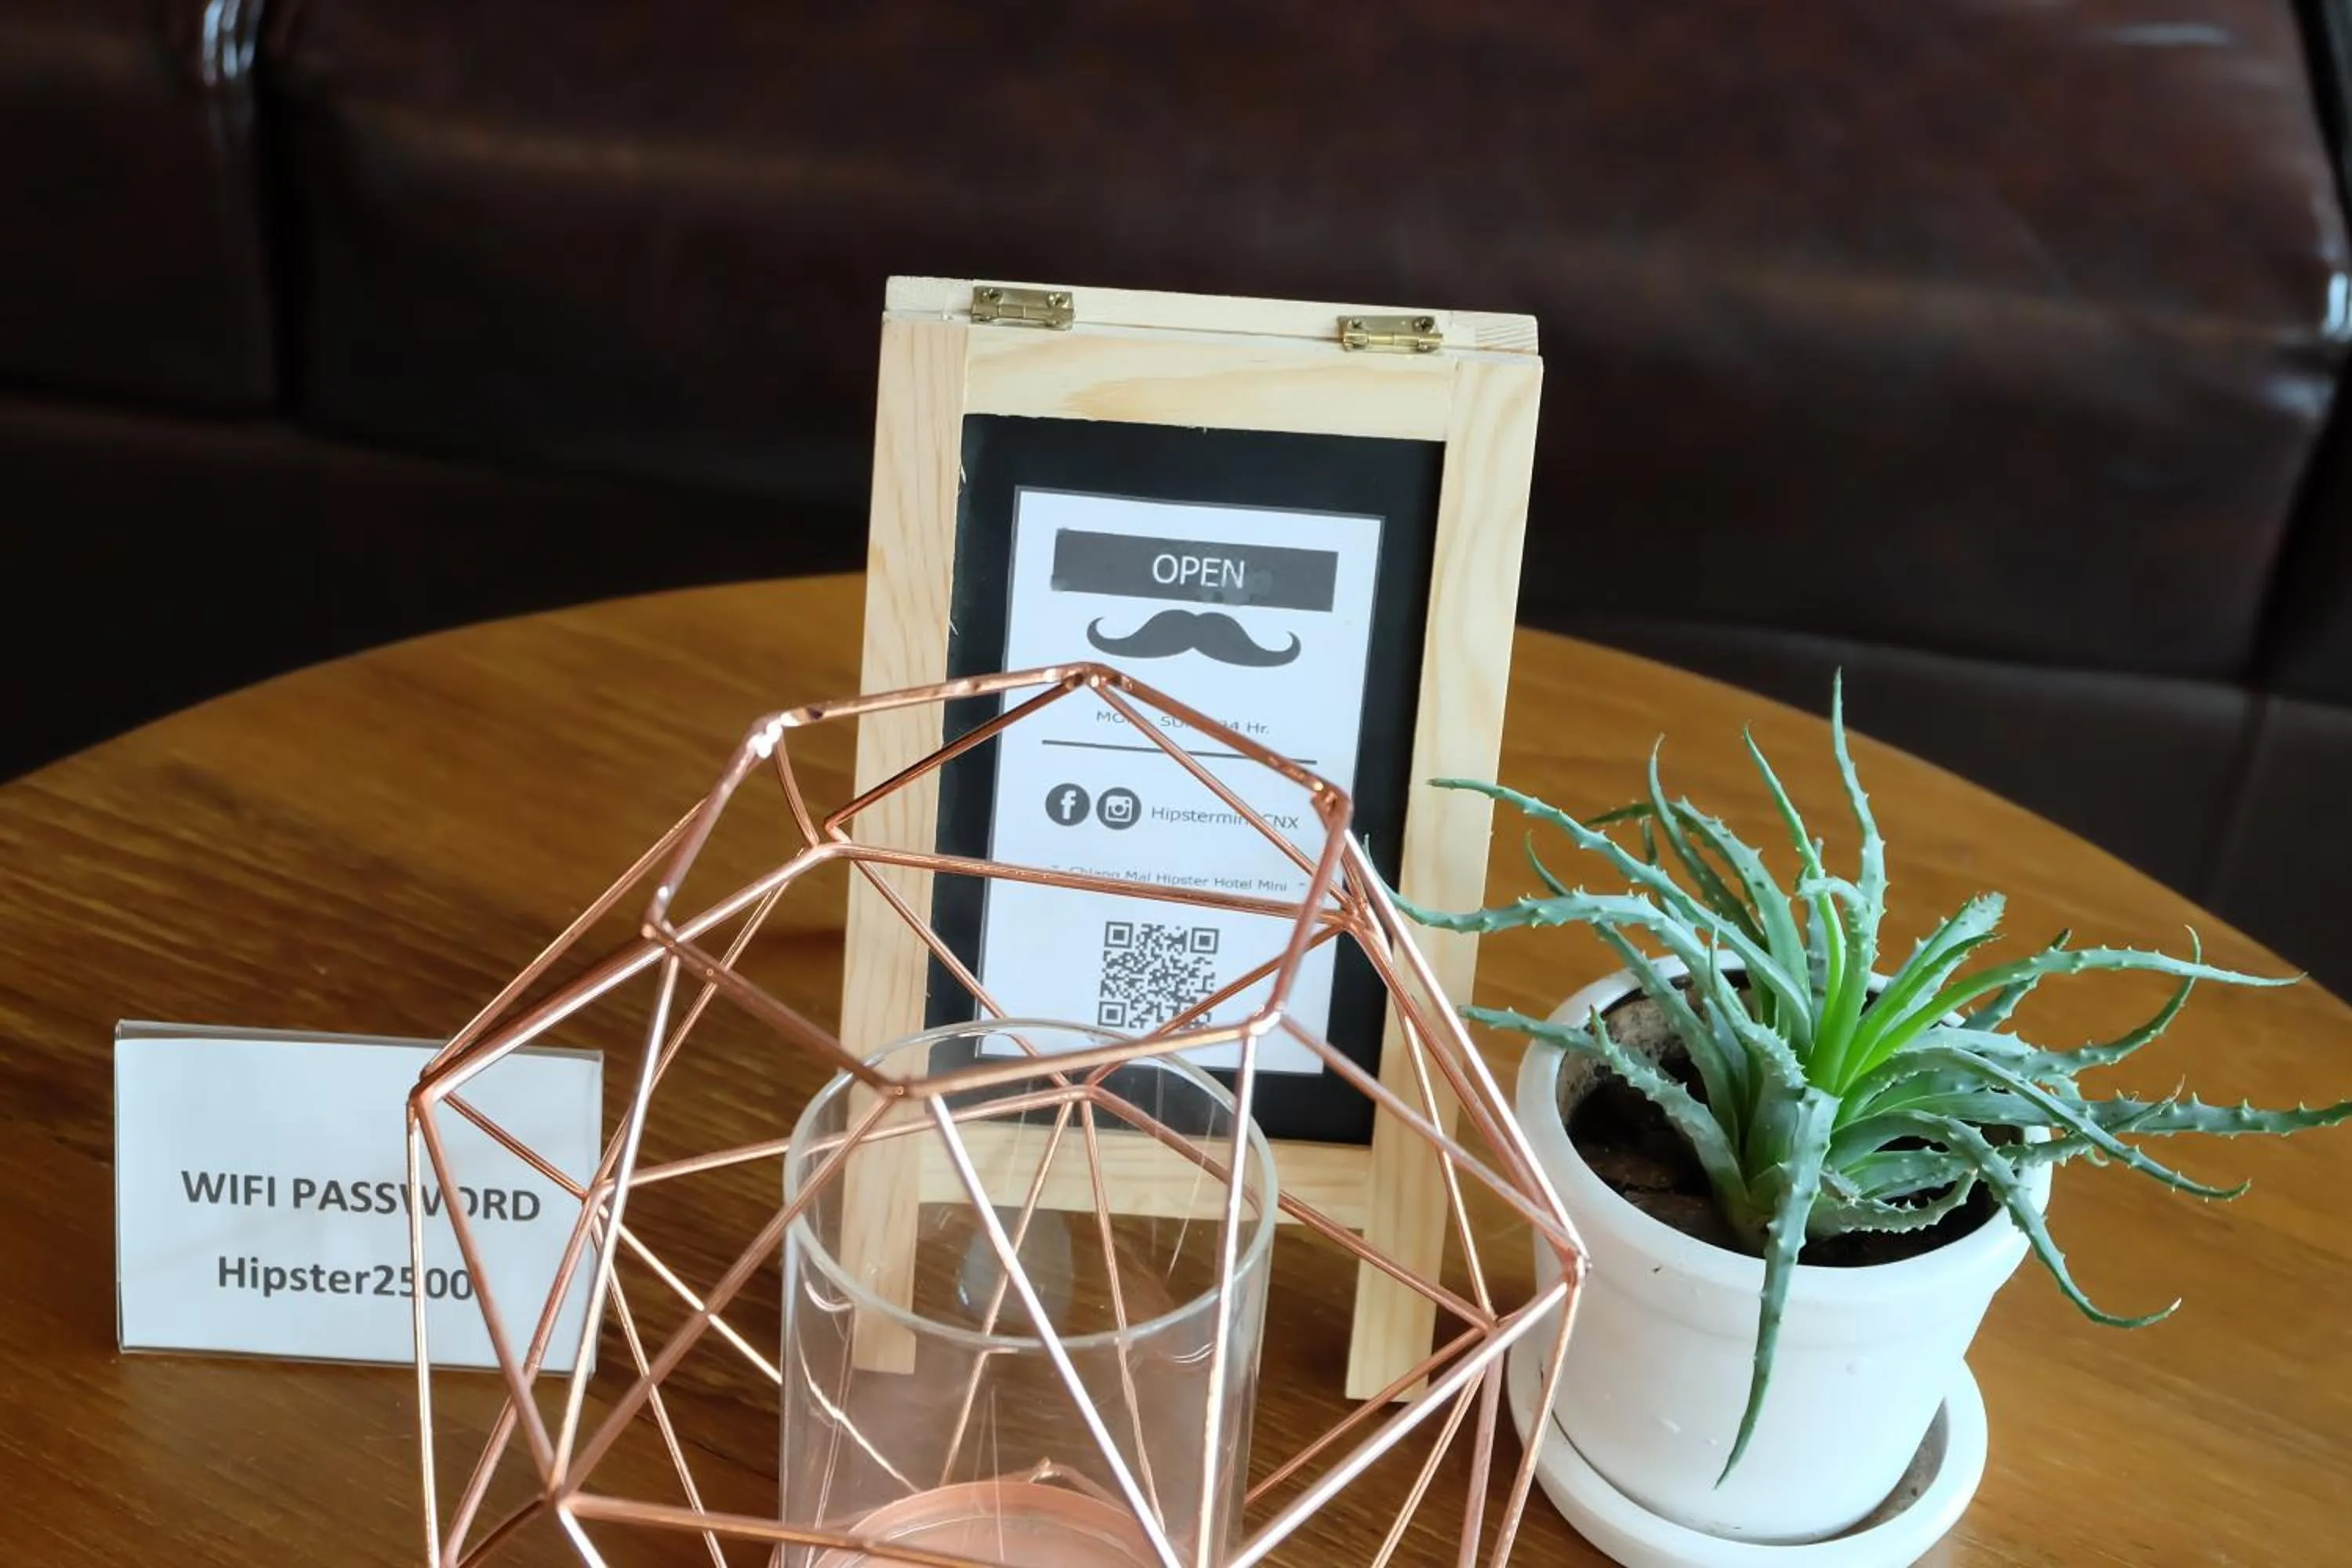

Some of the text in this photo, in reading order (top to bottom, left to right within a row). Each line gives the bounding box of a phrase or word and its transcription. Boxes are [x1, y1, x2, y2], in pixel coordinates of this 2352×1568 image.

[1152, 554, 1245, 590] OPEN
[1095, 711, 1139, 727] MO
[1160, 715, 1199, 730] SU
[1246, 721, 1269, 735] Hr.
[1156, 873, 1209, 887] Hipster
[1214, 877, 1252, 889] Hotel
[1258, 879, 1288, 892] Mini
[180, 1171, 276, 1207] WIFI
